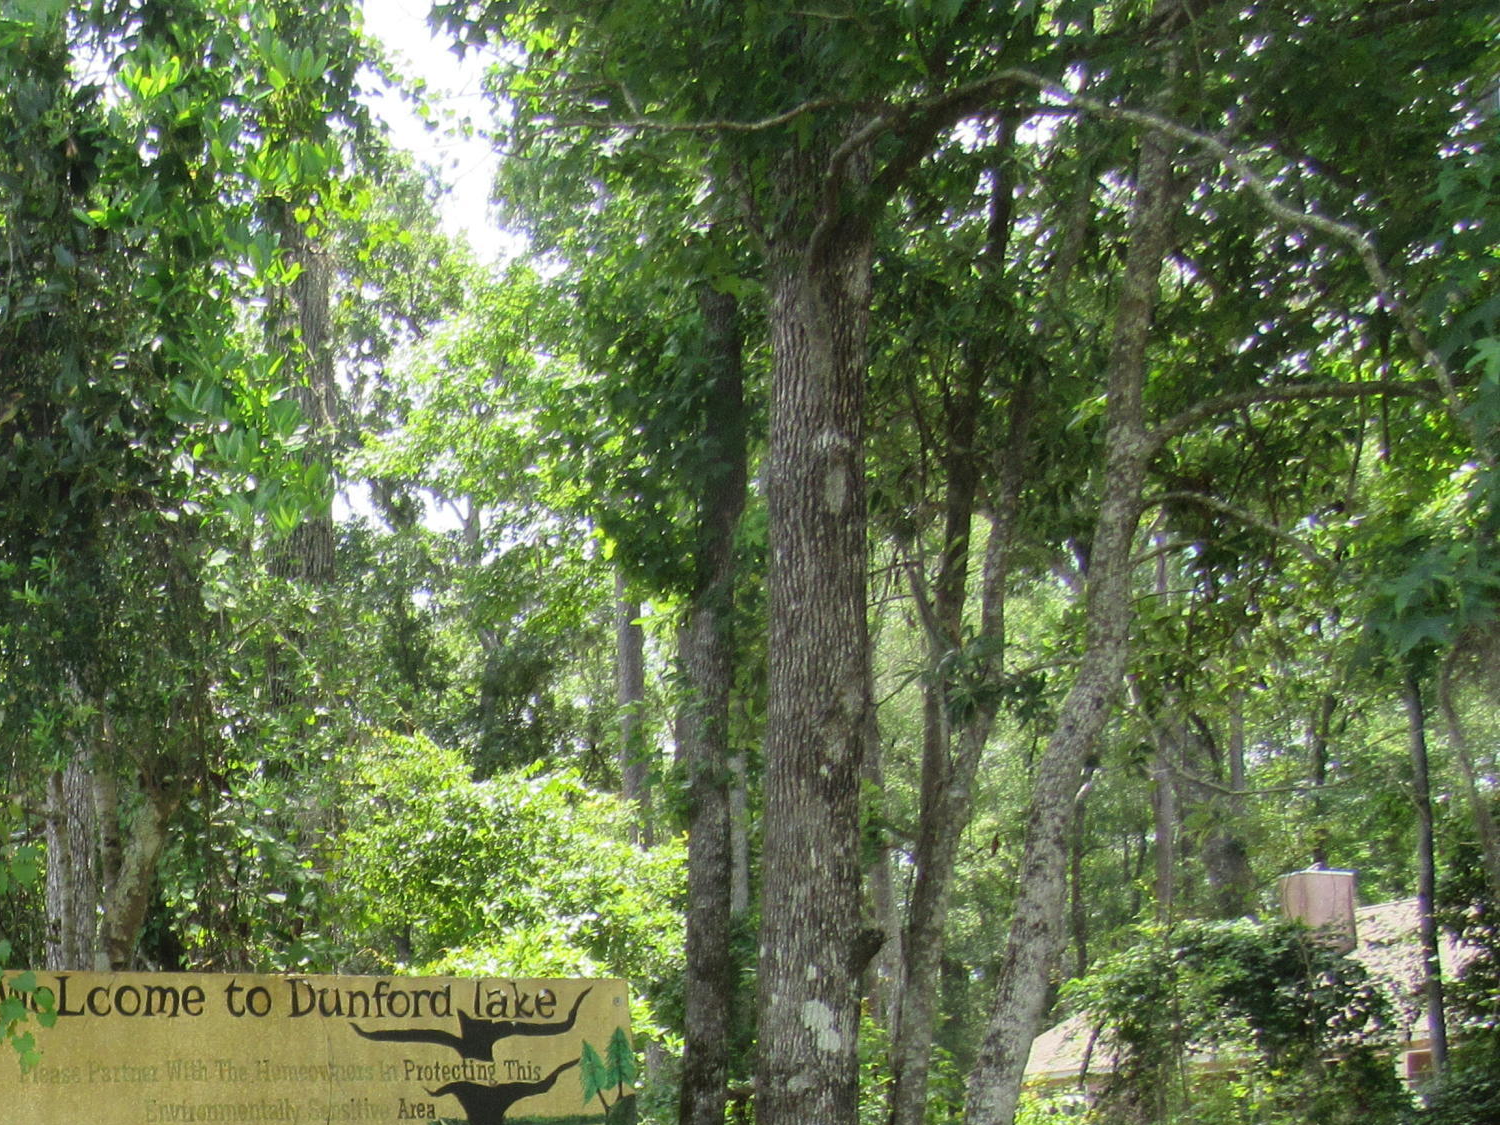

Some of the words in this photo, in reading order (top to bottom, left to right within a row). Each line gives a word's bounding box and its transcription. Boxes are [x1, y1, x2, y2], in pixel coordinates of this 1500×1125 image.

[224, 978, 272, 1017] to
[284, 979, 453, 1018] Dunford
[88, 1060, 158, 1083] Partner
[166, 1059, 208, 1082] With
[215, 1058, 248, 1083] The
[403, 1060, 496, 1085] Protecting
[503, 1059, 542, 1081] This
[396, 1098, 436, 1119] Area
